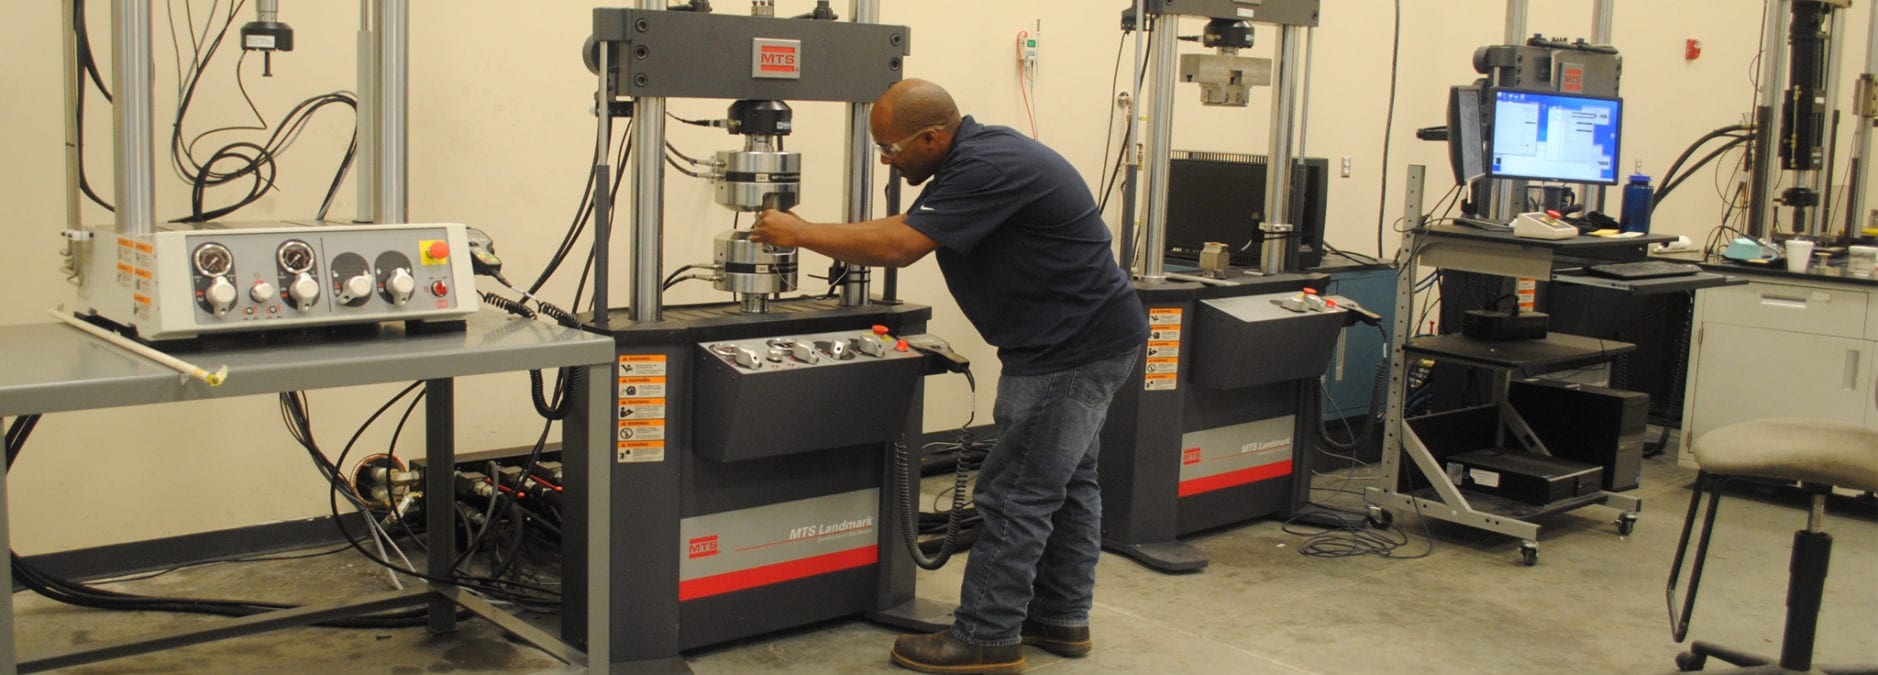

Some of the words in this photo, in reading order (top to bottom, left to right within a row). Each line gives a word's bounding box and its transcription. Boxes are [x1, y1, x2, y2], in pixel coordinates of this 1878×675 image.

[761, 53, 795, 65] MTS
[1564, 75, 1581, 84] MTS
[1241, 442, 1258, 453] MTS
[1259, 438, 1290, 450] Landmark
[1183, 453, 1201, 461] MTS
[789, 525, 817, 541] MTS
[819, 516, 873, 534] Landmark
[689, 541, 718, 553] MTS
